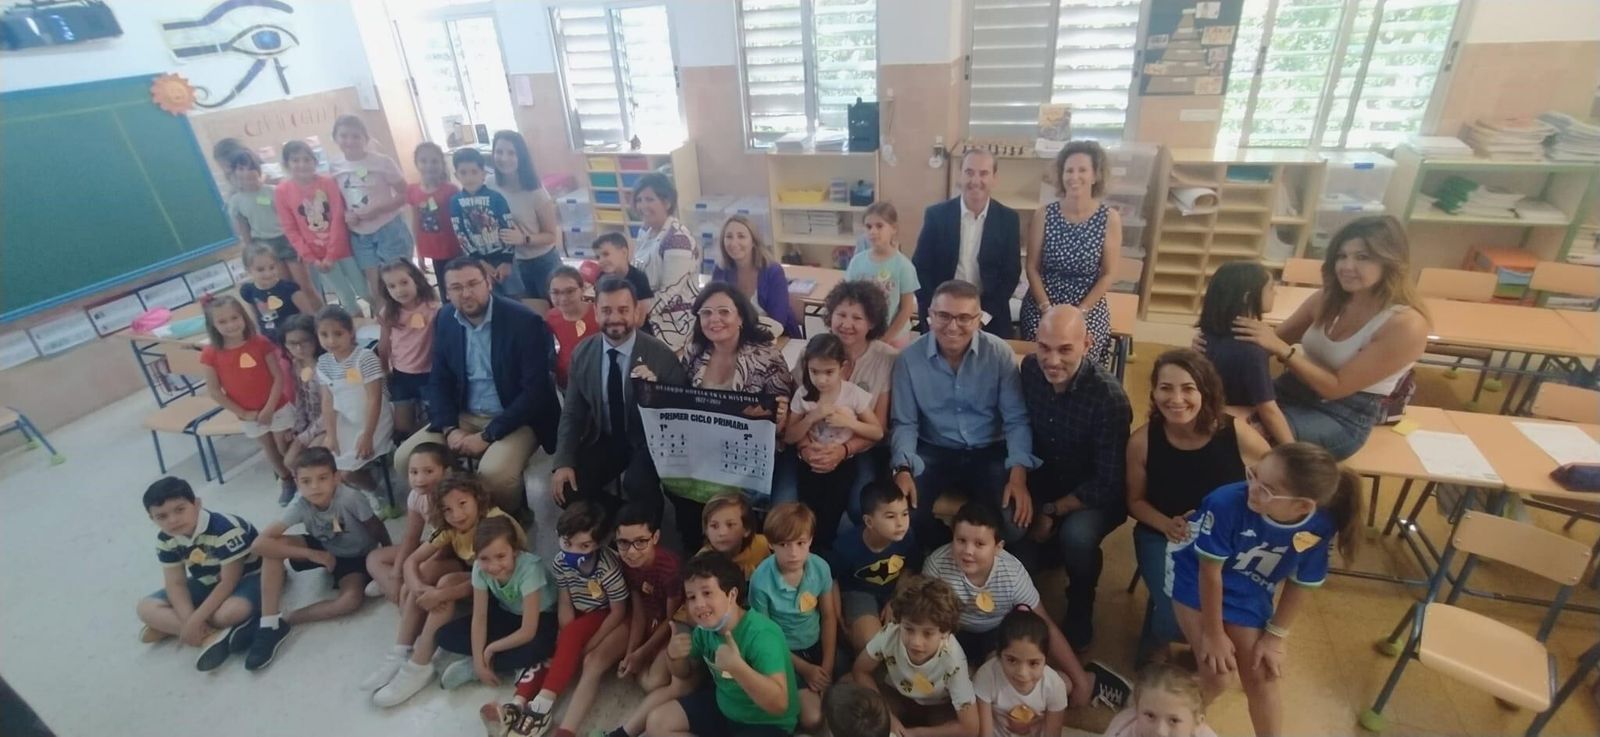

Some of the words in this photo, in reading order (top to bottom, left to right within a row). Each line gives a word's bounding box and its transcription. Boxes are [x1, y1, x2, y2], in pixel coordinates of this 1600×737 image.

[728, 394, 759, 403] HISTORIA
[660, 412, 689, 421] PRIMER
[690, 413, 712, 425] CICLO
[713, 416, 749, 431] PRIMARIA
[226, 536, 243, 550] 31
